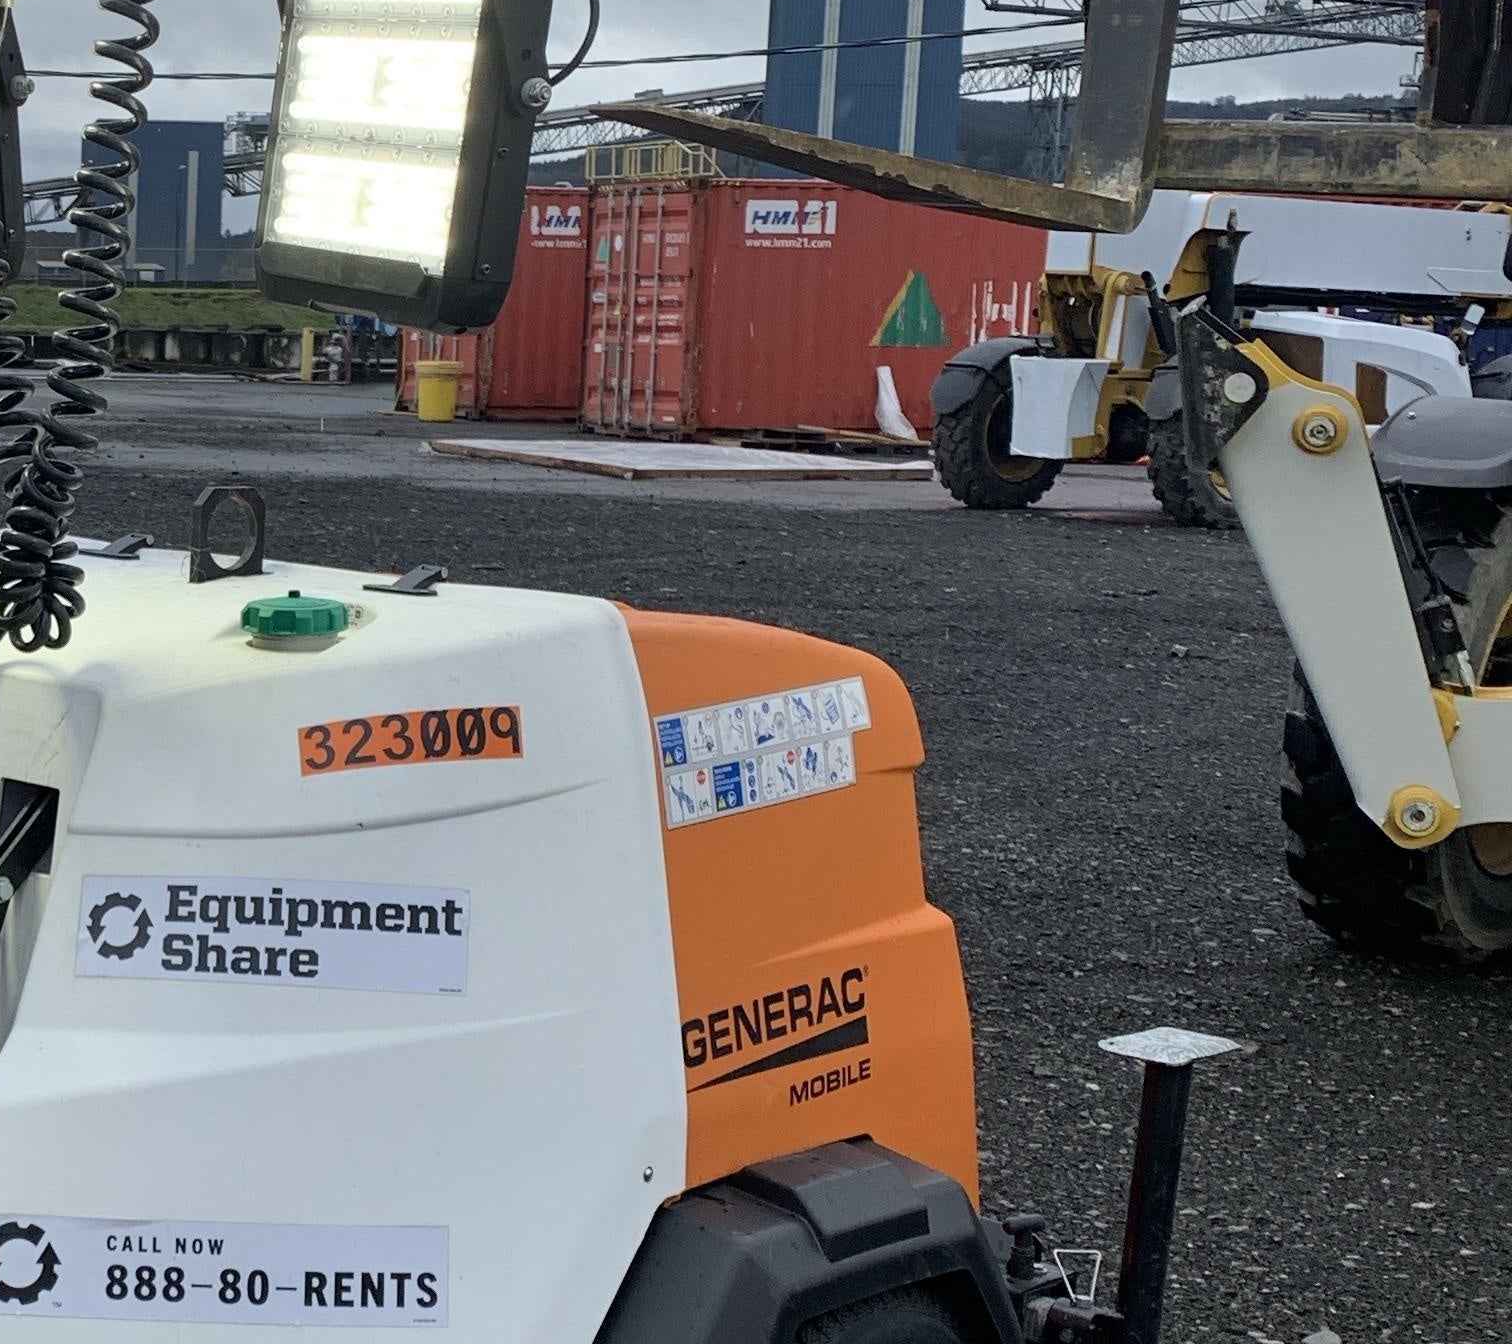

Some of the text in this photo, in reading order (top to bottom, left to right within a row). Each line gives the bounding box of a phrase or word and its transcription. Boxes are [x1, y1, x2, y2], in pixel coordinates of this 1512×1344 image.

[304, 707, 522, 770] 323009
[165, 885, 464, 937] Equipment
[161, 934, 320, 979] Share
[681, 967, 866, 1069] GENERAC
[790, 1058, 872, 1107] MOBILE
[106, 1235, 225, 1256] CALL NOW
[105, 1264, 439, 1309] 888-80-RENTS
